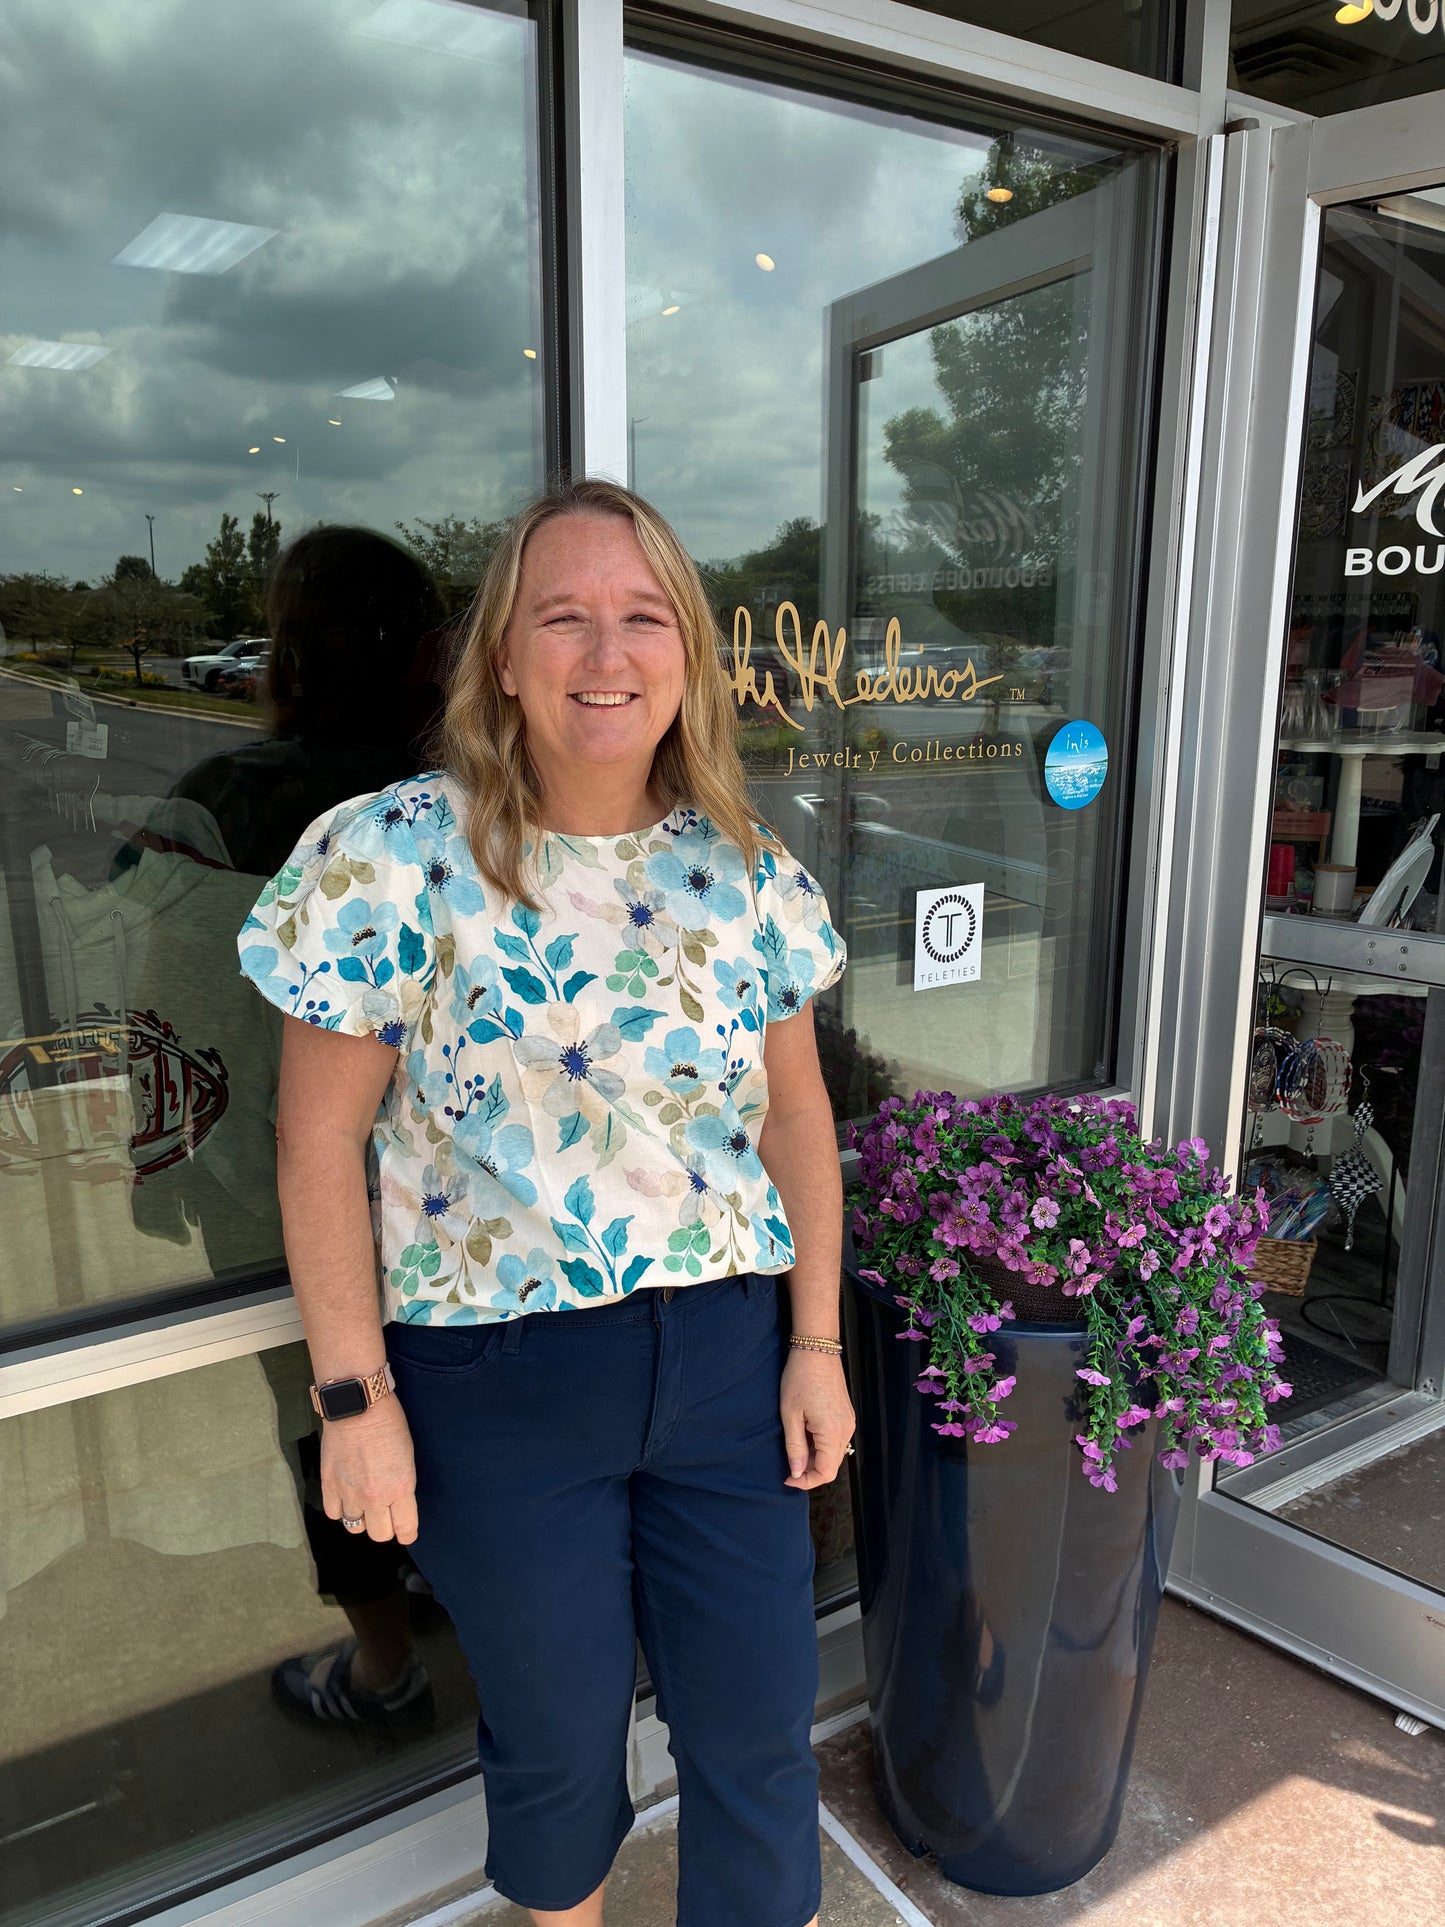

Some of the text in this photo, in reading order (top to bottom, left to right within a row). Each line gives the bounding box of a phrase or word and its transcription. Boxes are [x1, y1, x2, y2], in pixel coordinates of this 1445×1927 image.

[1344, 545, 1445, 576] BOU
[776, 601, 1004, 711] Medeiros
[1010, 688, 1025, 700] TM
[784, 738, 1023, 776] Jewelry Collections
[1066, 733, 1089, 753] inis
[920, 965, 976, 984] TELETIES
